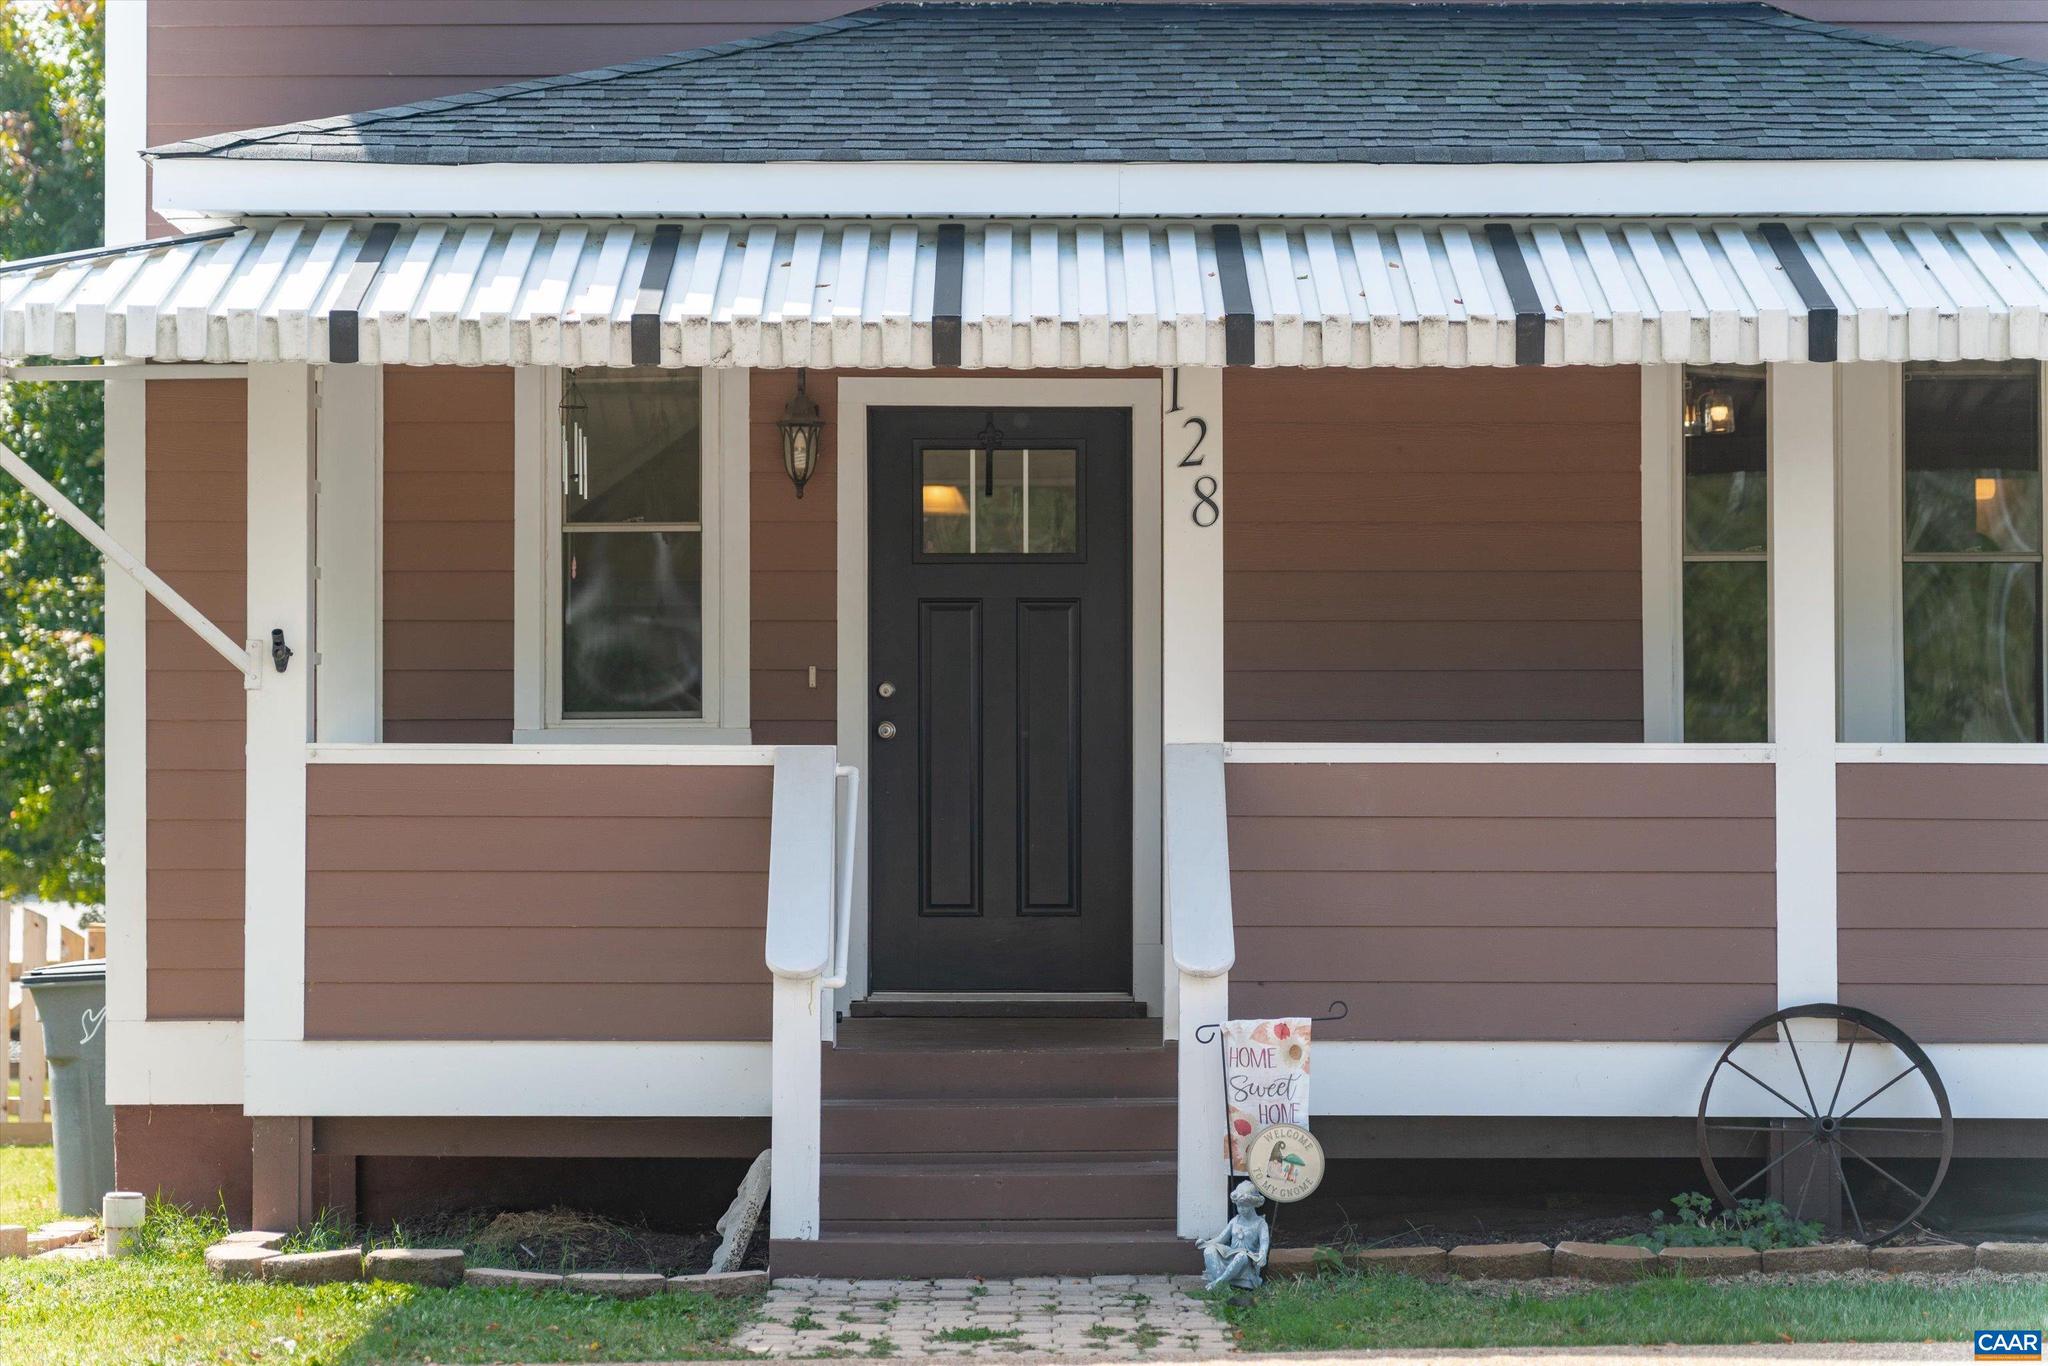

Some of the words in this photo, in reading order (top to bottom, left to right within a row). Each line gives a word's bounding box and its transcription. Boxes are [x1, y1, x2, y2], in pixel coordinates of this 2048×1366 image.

[1165, 367, 1220, 529] 128
[1229, 1046, 1277, 1069] HOME
[1229, 1073, 1302, 1102] Sweet
[1263, 1129, 1314, 1152] WELCOME
[1253, 1167, 1264, 1180] TO
[1262, 1180, 1278, 1193] MY
[1280, 1176, 1314, 1197] GNOME
